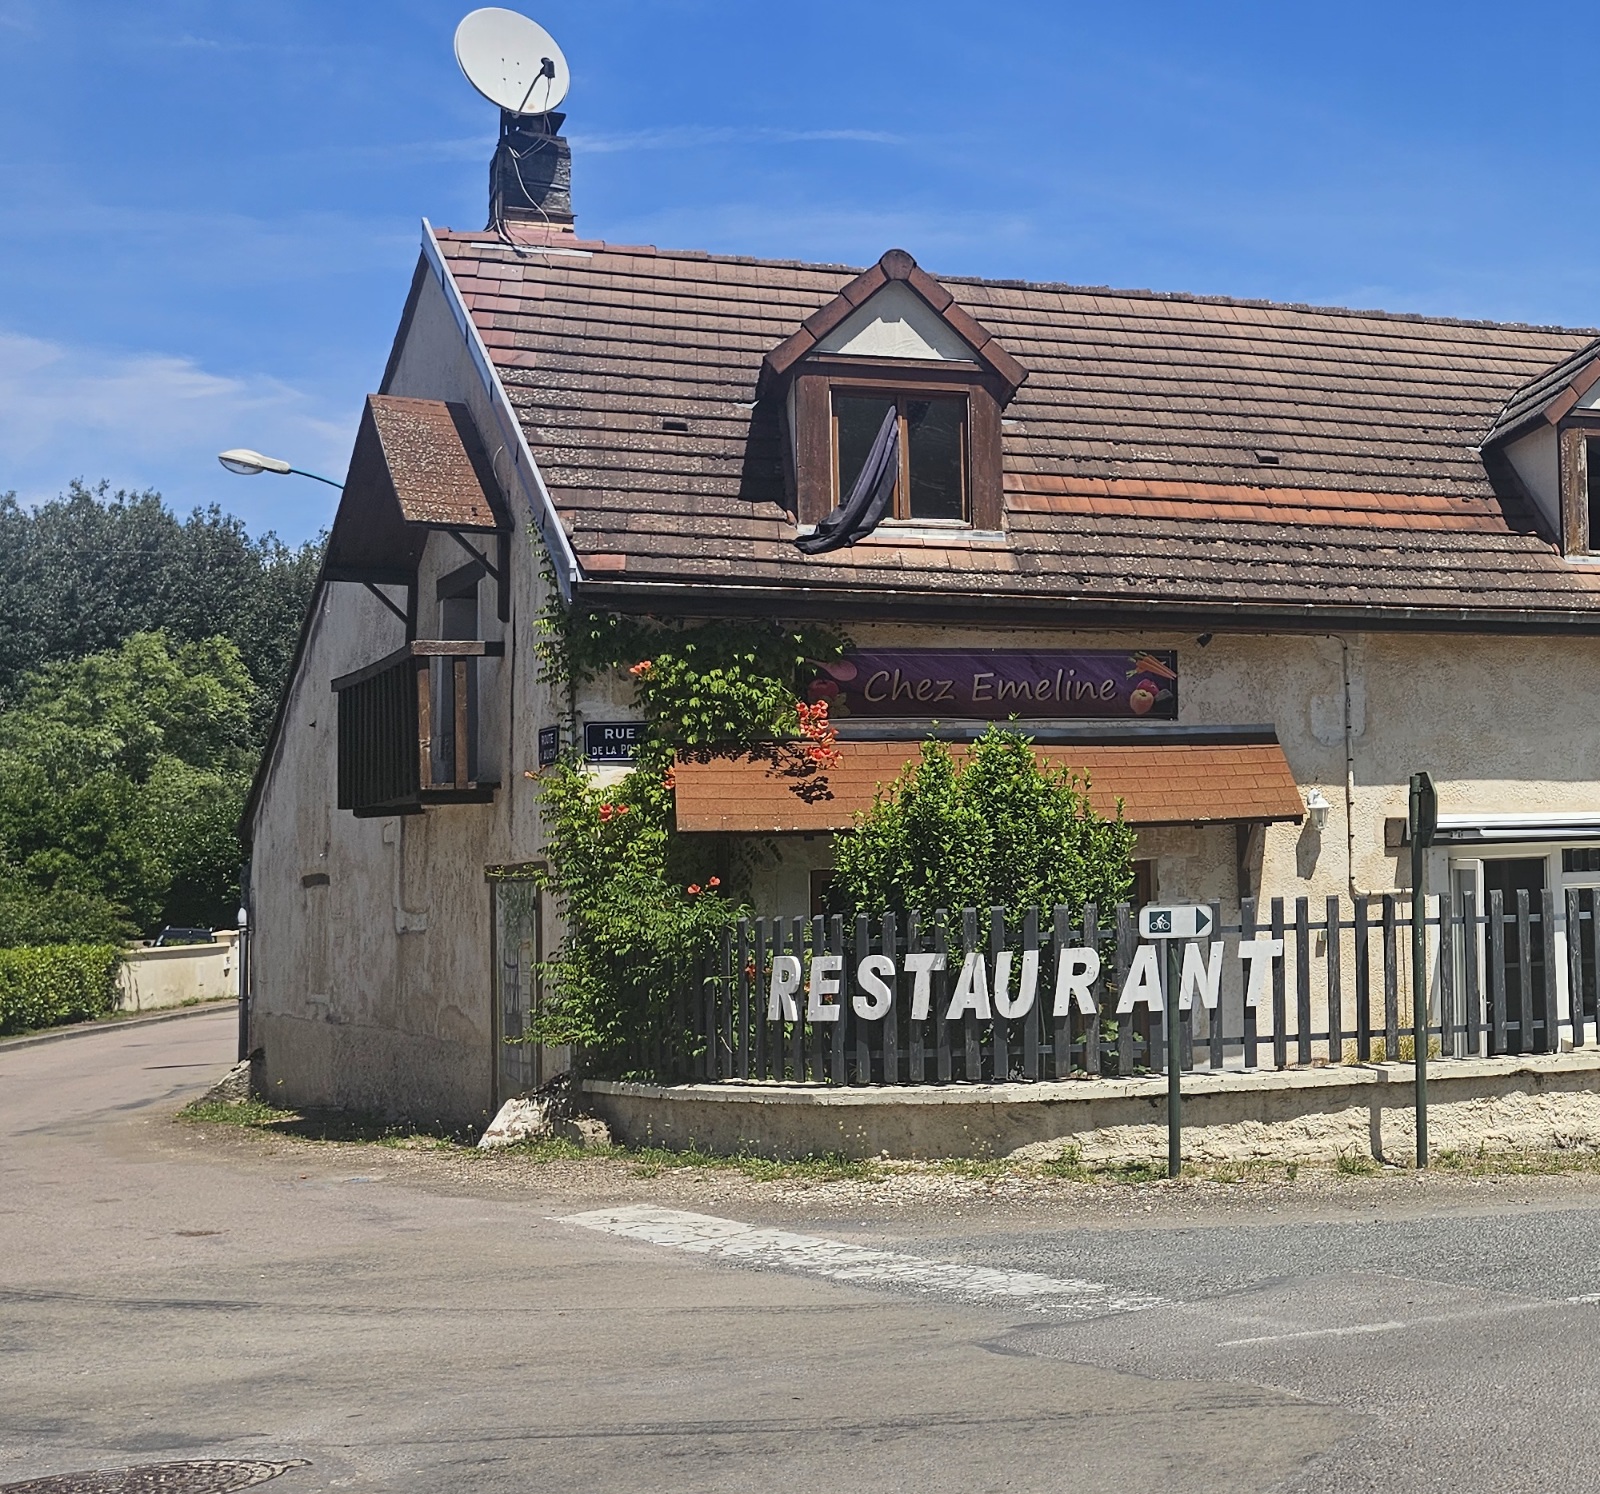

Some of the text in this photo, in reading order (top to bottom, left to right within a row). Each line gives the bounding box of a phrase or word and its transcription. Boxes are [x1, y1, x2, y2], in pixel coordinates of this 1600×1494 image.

[864, 668, 1117, 702] Chez Emeline
[604, 728, 635, 739] RUE
[592, 746, 603, 756] DE
[605, 745, 617, 755] LA
[766, 939, 1284, 1022] RESTAURANT
